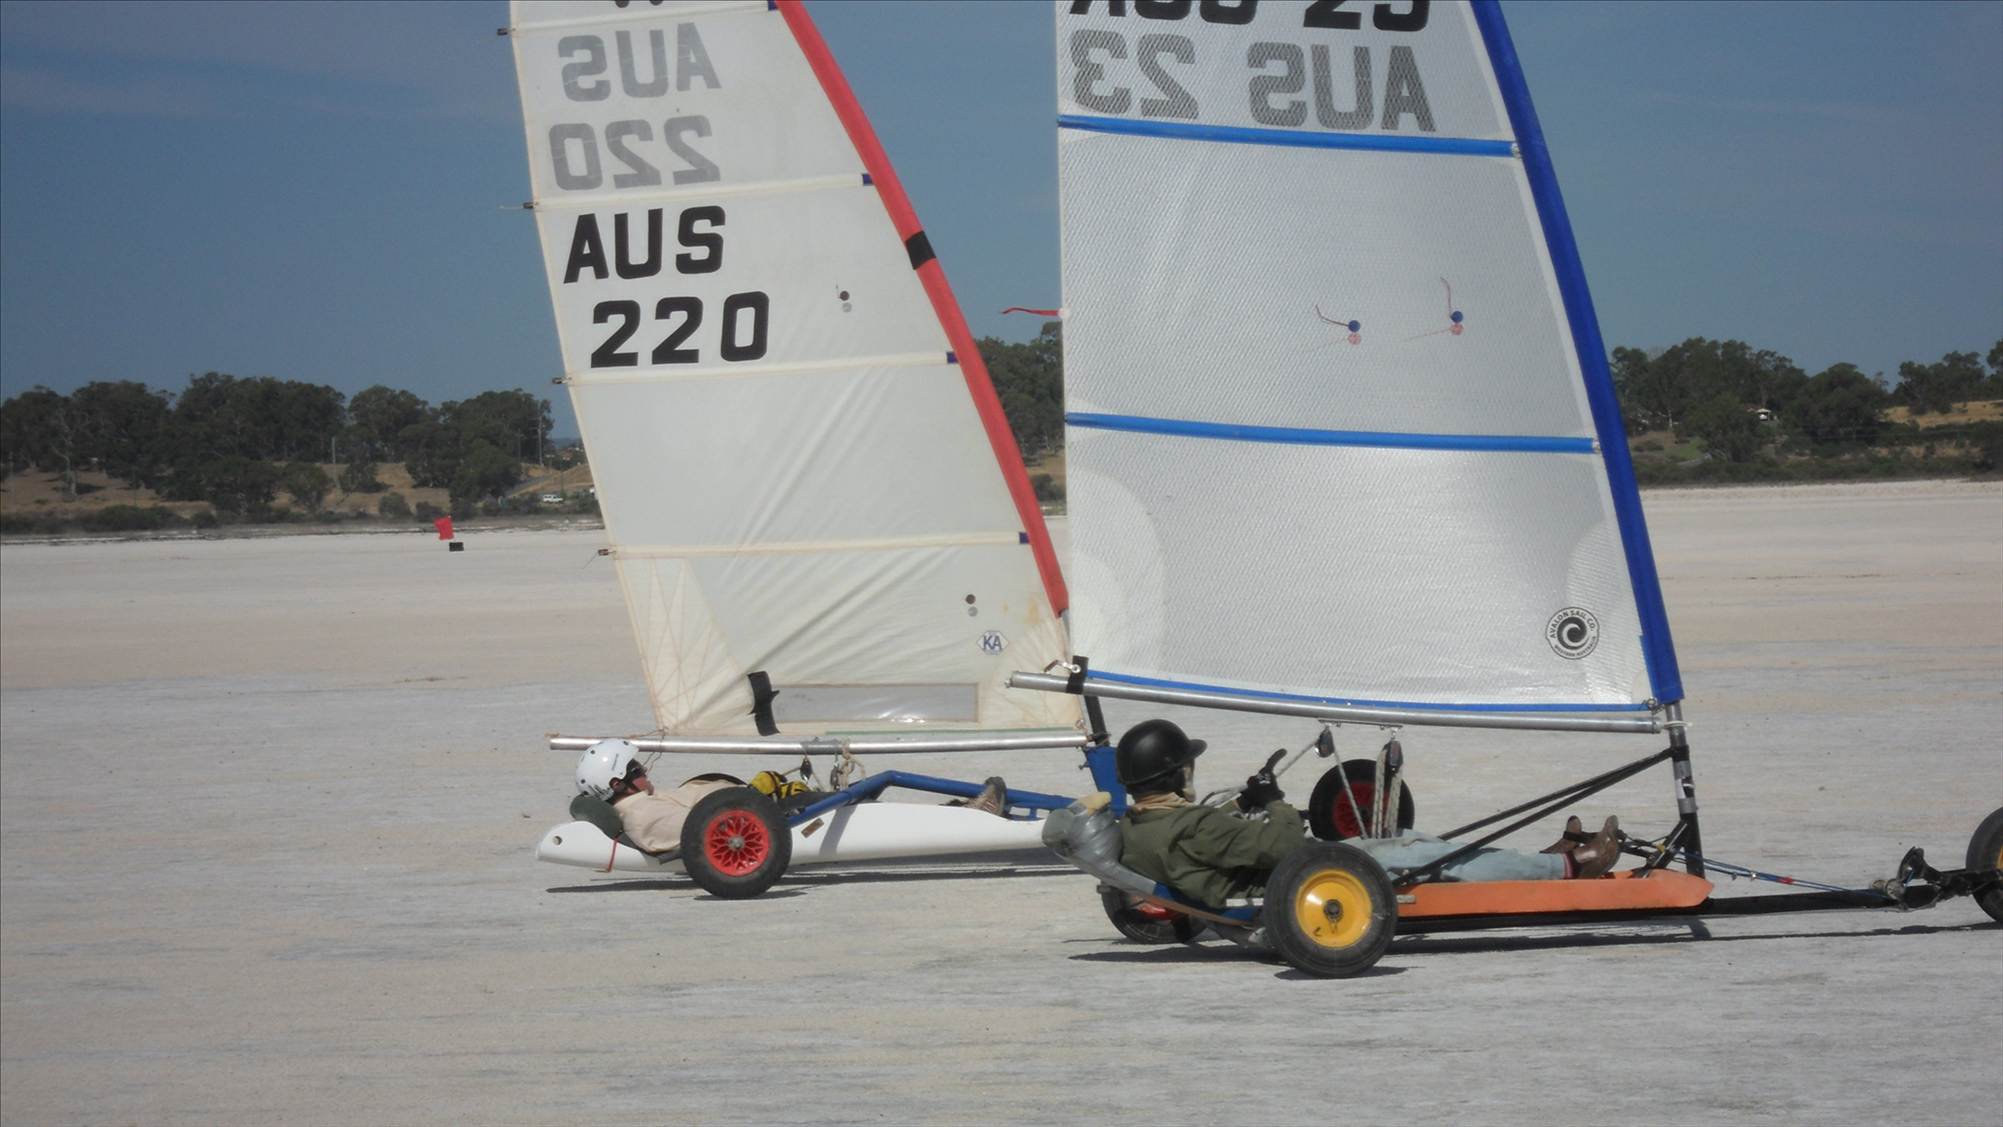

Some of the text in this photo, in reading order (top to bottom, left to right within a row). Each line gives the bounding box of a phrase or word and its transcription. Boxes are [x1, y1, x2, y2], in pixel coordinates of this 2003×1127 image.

[563, 205, 726, 284] AUS
[590, 290, 770, 368] 220
[983, 635, 1003, 651] KA
